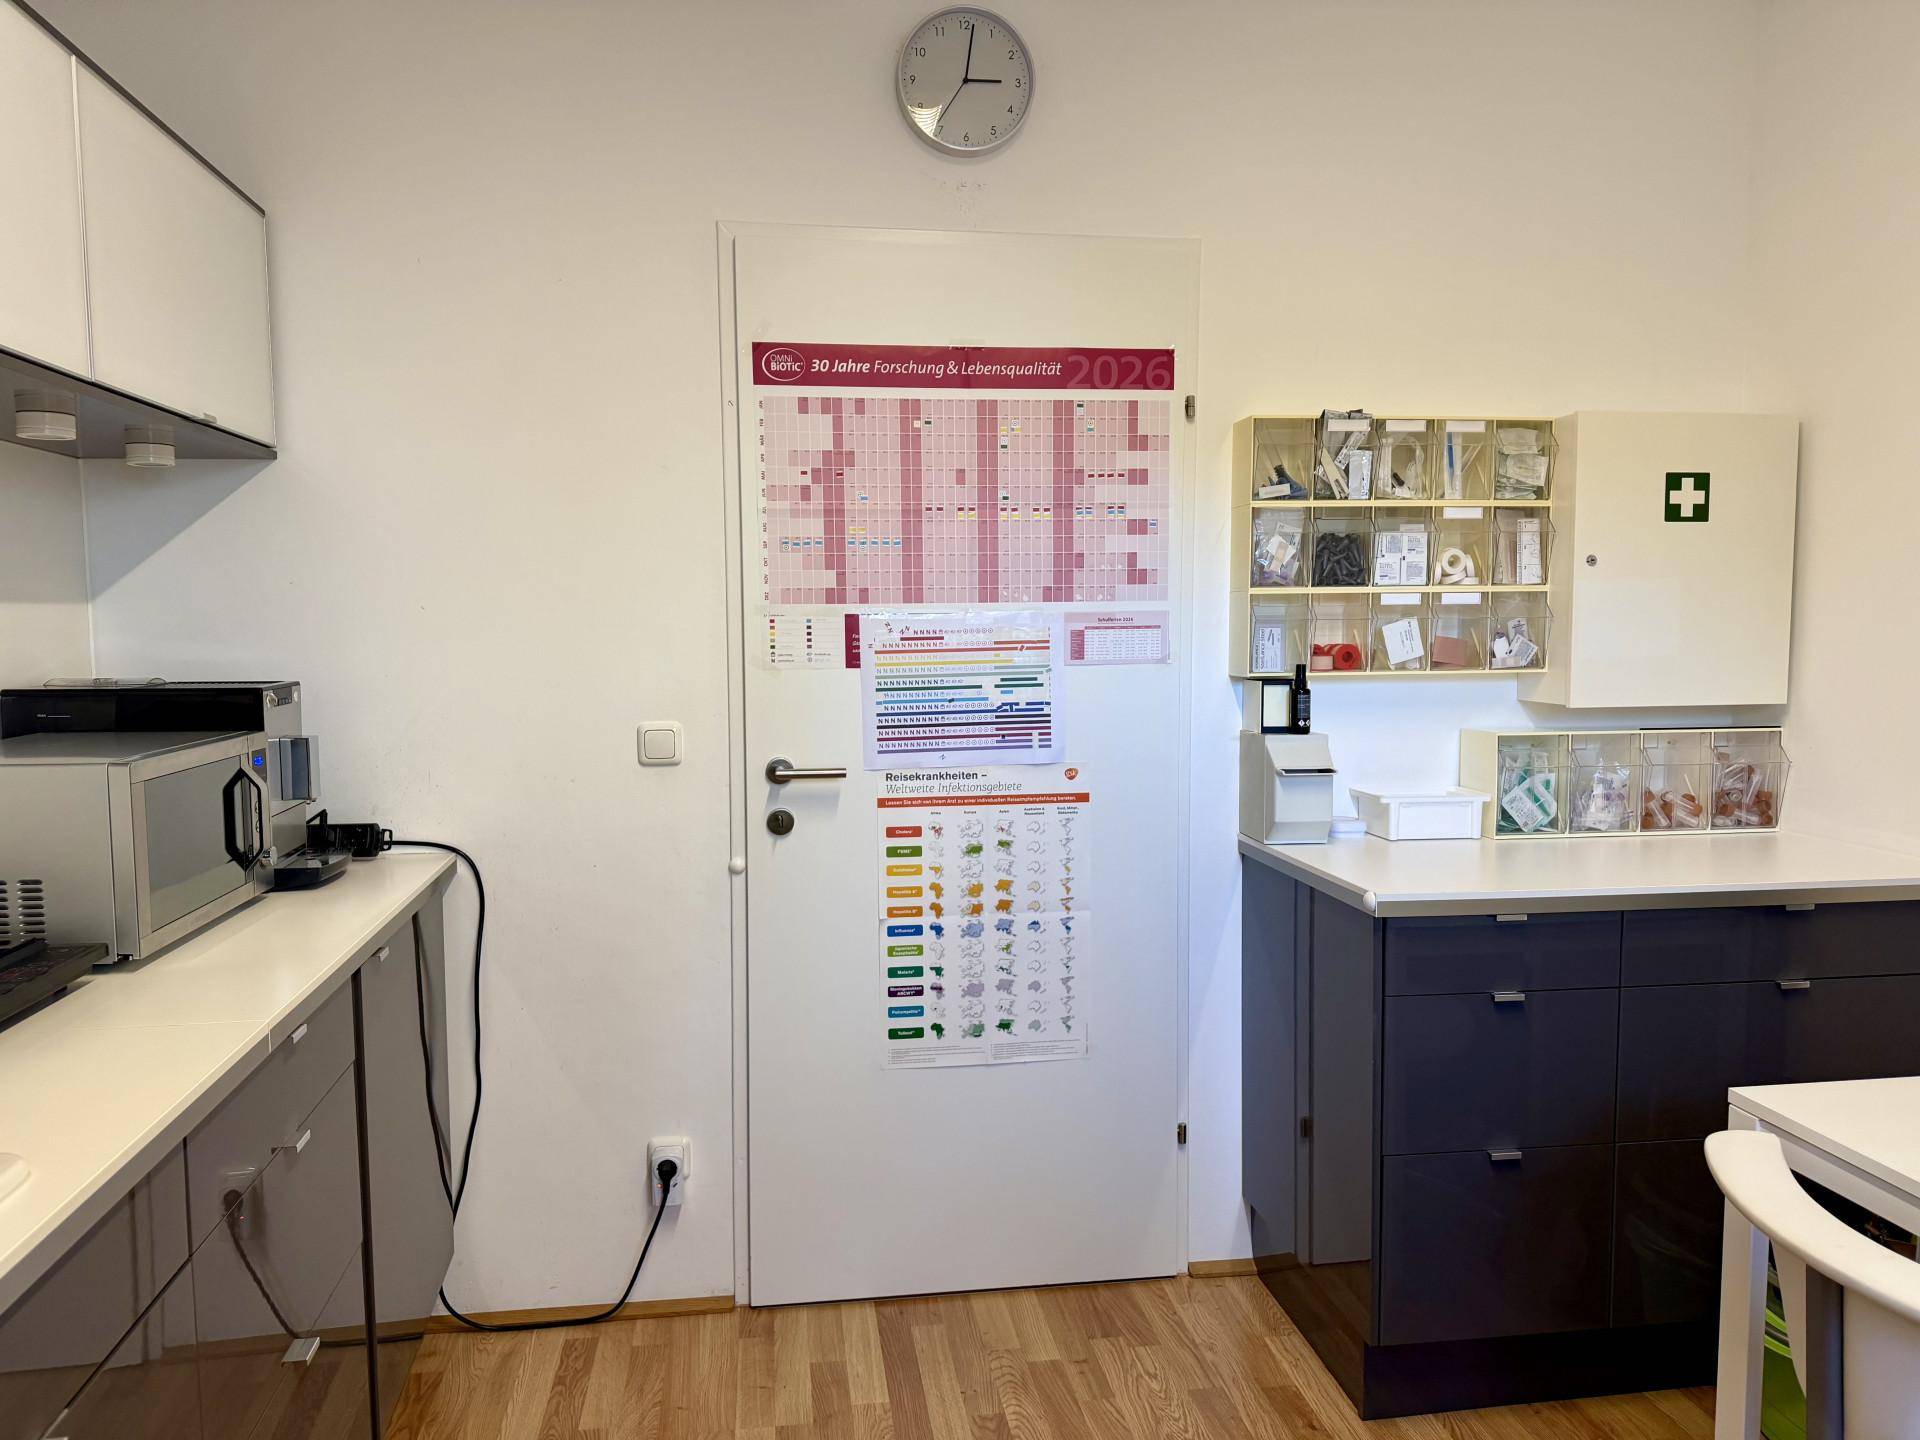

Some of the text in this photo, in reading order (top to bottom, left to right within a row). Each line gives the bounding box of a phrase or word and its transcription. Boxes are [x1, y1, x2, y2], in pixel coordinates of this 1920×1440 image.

[959, 20, 970, 30] 12
[935, 27, 945, 36] 11
[914, 48, 926, 57] 10
[1008, 50, 1014, 59] 2
[910, 75, 916, 84] 9
[1015, 79, 1021, 87] 3
[1008, 105, 1013, 114] 4
[938, 126, 944, 134] 7
[990, 126, 996, 135] 5
[964, 133, 969, 142] 6
[811, 359, 1062, 378] 30 Jahre Forschung & Lebensqualität
[1066, 355, 1170, 389] 2026
[886, 771, 978, 782] Reisekrankheiten
[886, 781, 1022, 794] Weltweite Infektionsgebiete
